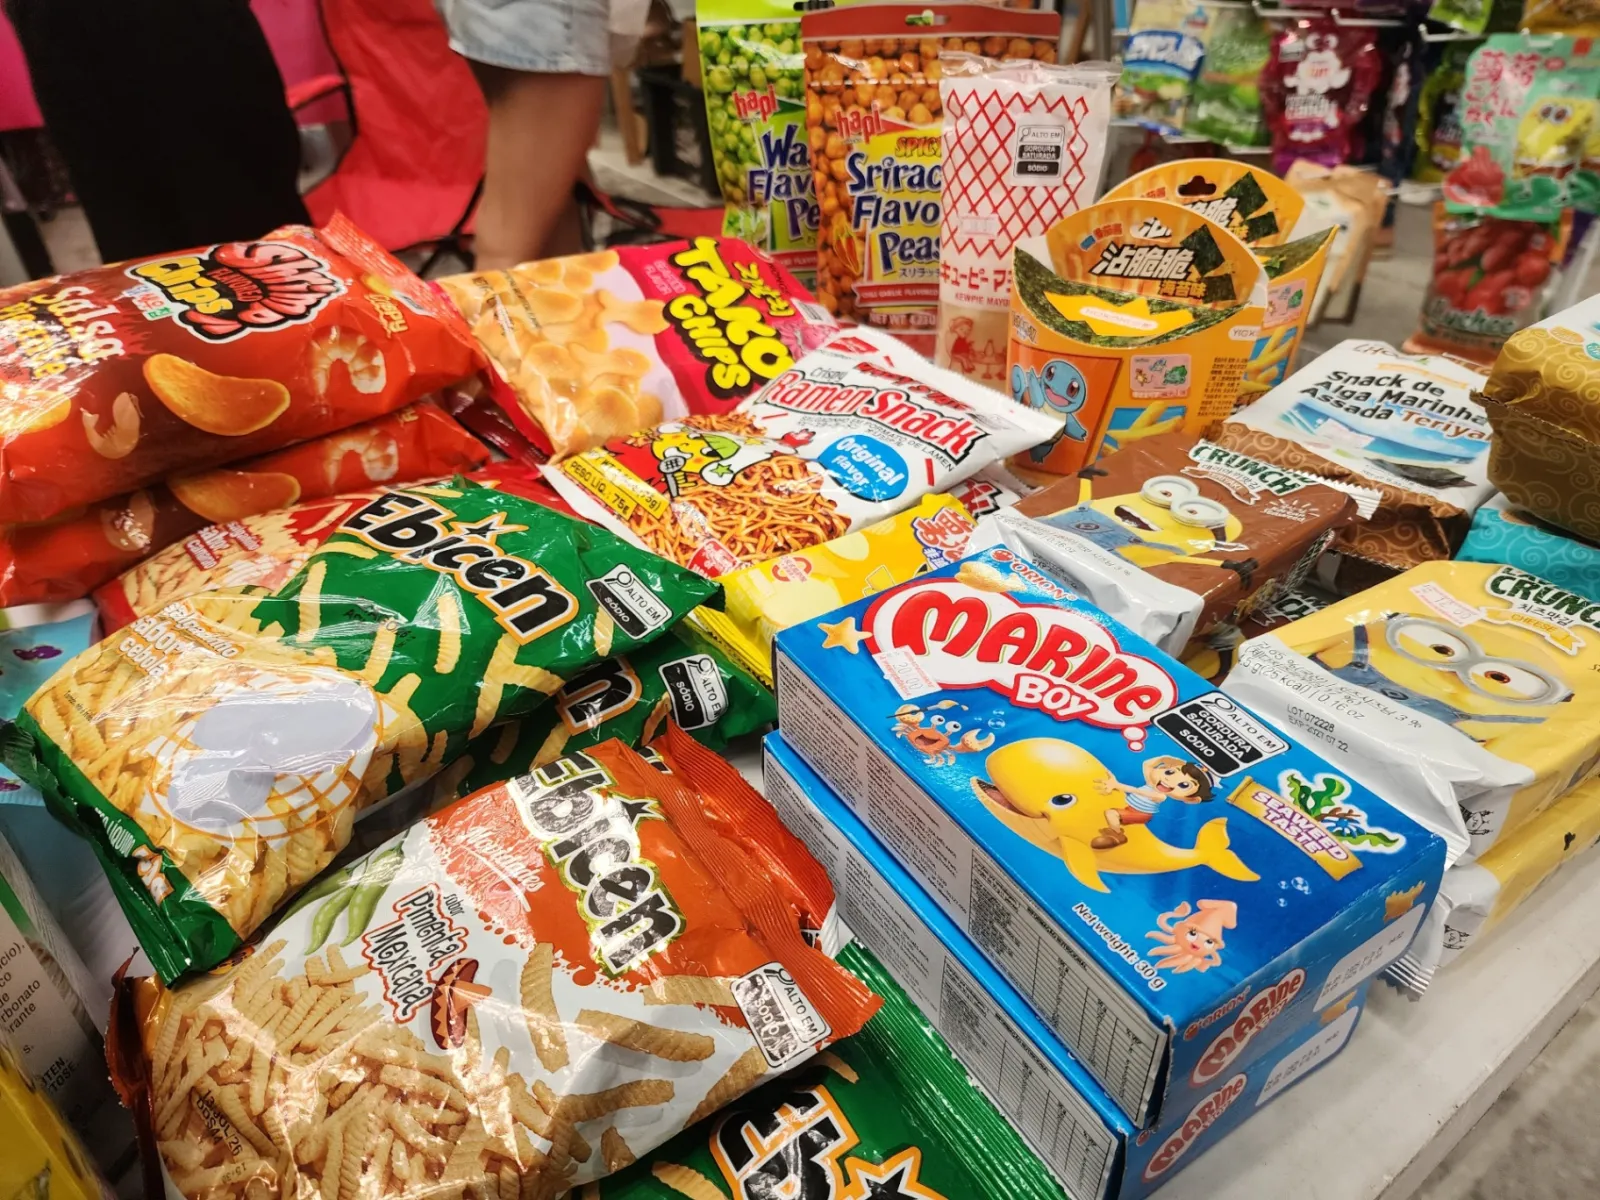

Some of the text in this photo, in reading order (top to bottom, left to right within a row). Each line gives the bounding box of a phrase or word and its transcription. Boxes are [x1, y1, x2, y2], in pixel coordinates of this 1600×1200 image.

[732, 84, 778, 123] hapi
[835, 100, 883, 144] hapi
[761, 124, 809, 170] Wa
[1031, 131, 1061, 139] ALTO EM
[847, 151, 942, 194] Srirac
[853, 194, 940, 231] Flavo
[668, 293, 752, 390] CHIPS
[1299, 387, 1395, 421] Assada
[1314, 380, 1490, 427] Alga Marinha
[1326, 370, 1446, 398] Snack de
[765, 370, 873, 416] Ramen
[858, 388, 984, 456] Snack
[835, 437, 905, 487] Original
[907, 438, 923, 451] DE
[568, 460, 591, 481] PESO
[602, 595, 632, 624] SÓDIO
[626, 584, 661, 623] ALTO EM
[1510, 612, 1557, 633] CHEESE
[118, 636, 170, 678] cebola
[675, 680, 696, 713] SÓDIO
[700, 676, 718, 702] ALTO
[1015, 676, 1096, 718] BOY
[1178, 728, 1216, 758] SÓDIO
[1186, 711, 1245, 759] SATURADA
[1197, 709, 1253, 754] GORDURA
[1227, 713, 1278, 751] ALTO EM
[1251, 790, 1350, 862] SEAWEED
[1263, 807, 1323, 855] TASTE
[408, 889, 461, 969] Pimenta
[1073, 902, 1097, 925] Net
[1094, 920, 1139, 965] weight:
[1135, 960, 1156, 980] 30
[374, 923, 434, 1018] Mexicana
[754, 997, 781, 1035] SÓDIO
[784, 986, 818, 1038] ALTO EM
